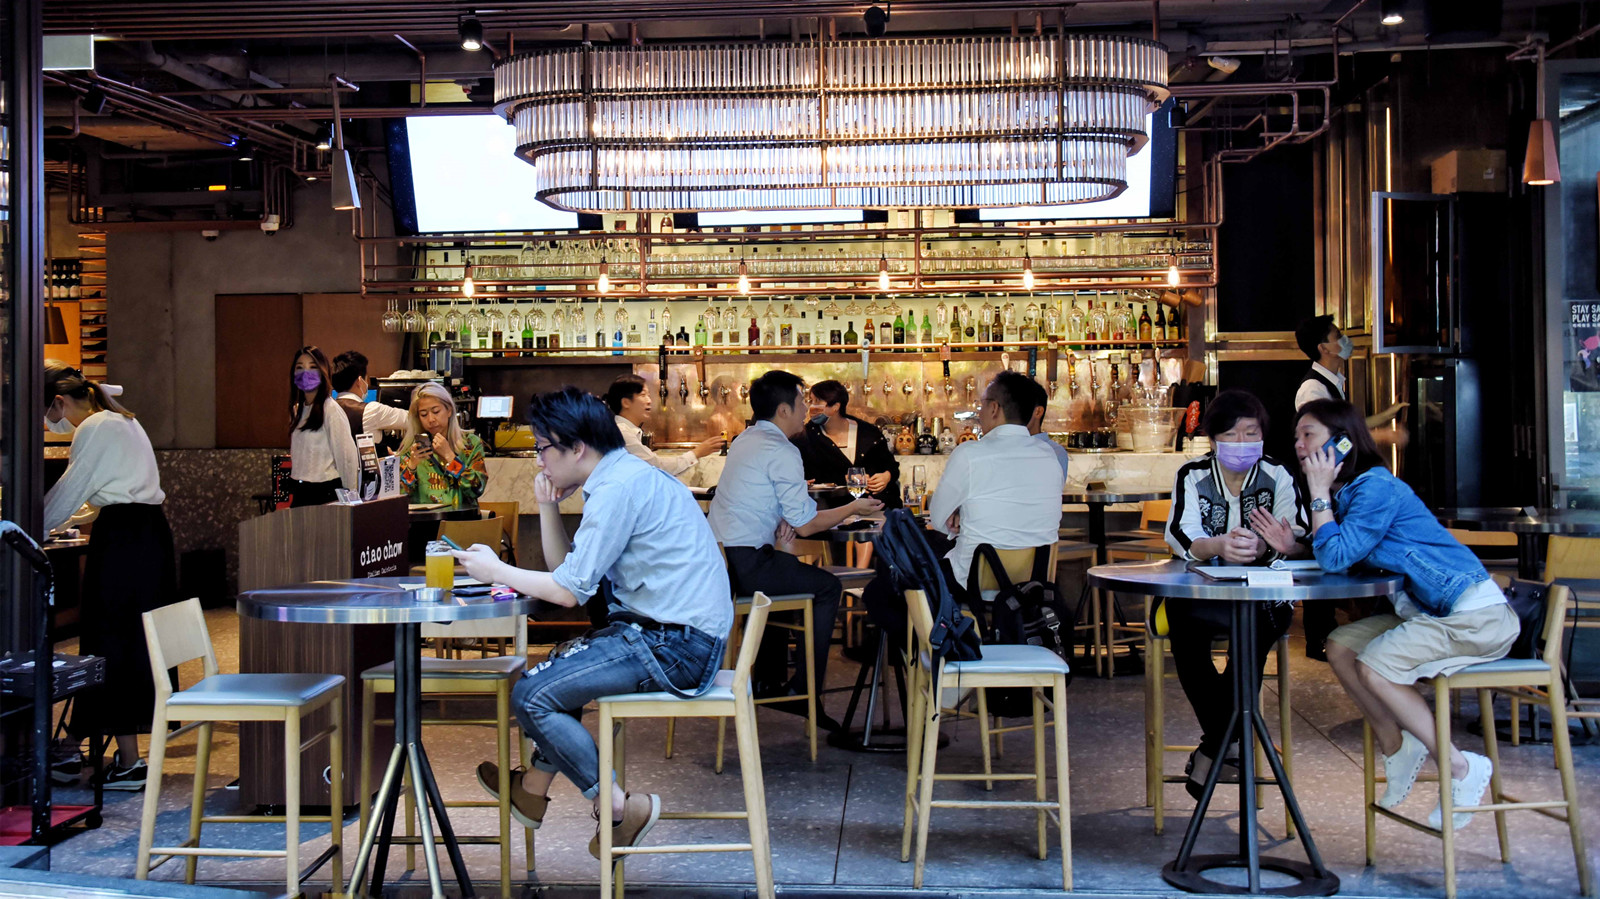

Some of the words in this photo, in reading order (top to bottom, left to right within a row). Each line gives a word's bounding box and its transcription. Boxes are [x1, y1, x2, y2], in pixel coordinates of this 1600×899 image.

[1572, 304, 1589, 314] STAY
[1572, 314, 1590, 323] PLAY
[360, 545, 382, 566] ciao
[383, 539, 403, 560] chow
